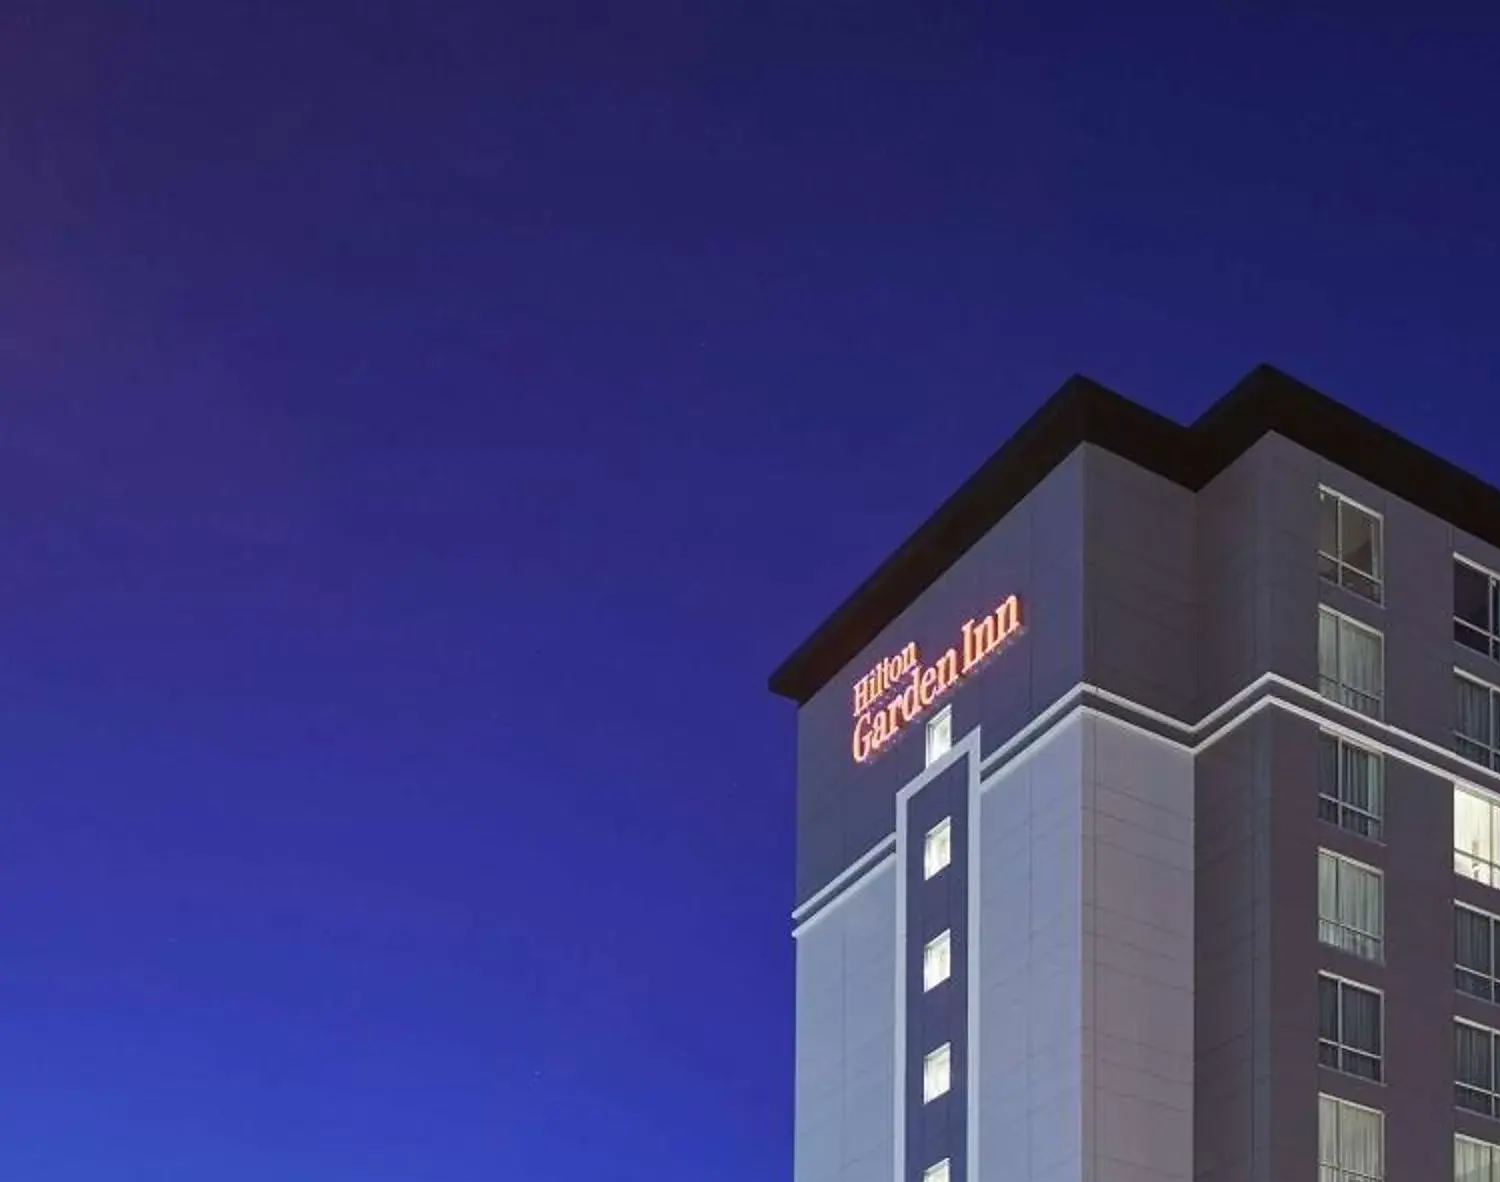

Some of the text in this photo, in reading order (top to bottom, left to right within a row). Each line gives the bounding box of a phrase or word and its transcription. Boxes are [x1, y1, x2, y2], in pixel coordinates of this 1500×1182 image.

[853, 641, 917, 716] Hilton
[853, 594, 1019, 763] Garden Inn
